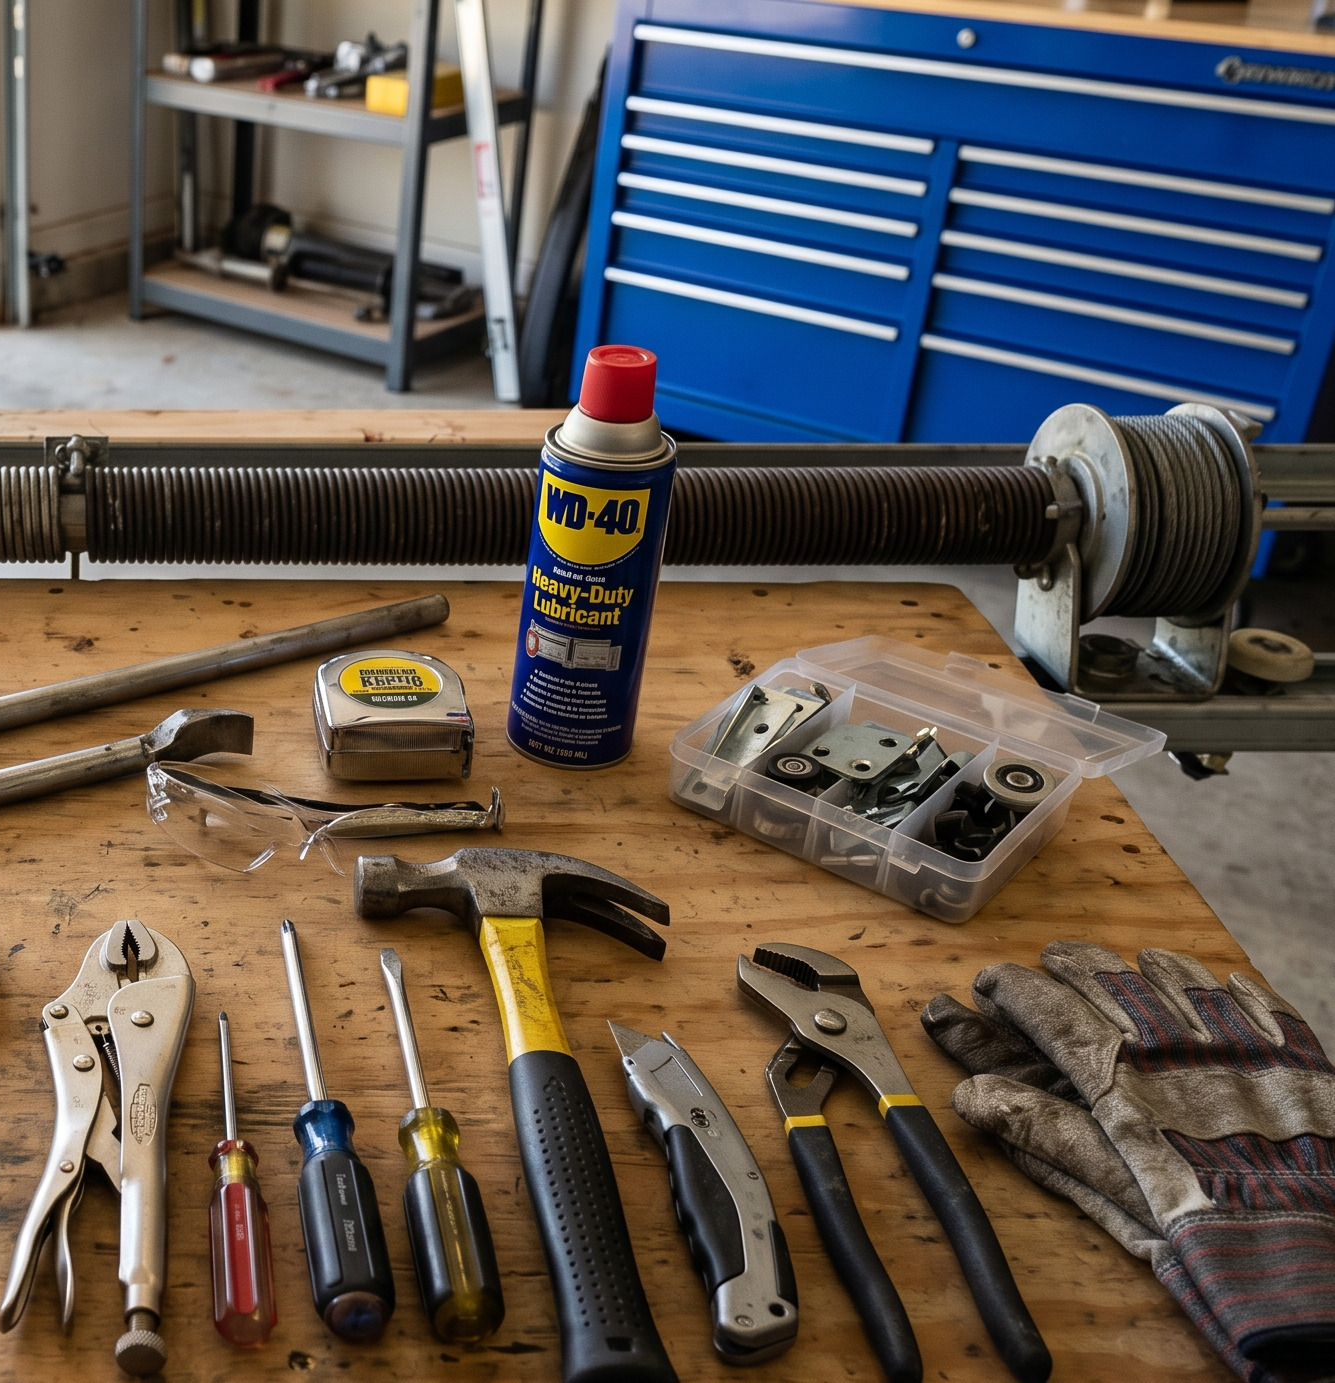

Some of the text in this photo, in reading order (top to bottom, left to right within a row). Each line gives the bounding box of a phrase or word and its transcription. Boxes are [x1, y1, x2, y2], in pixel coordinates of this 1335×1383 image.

[547, 483, 640, 535] WD-40
[532, 565, 634, 607] Heavy-Duty
[533, 590, 621, 625] Lubricant
